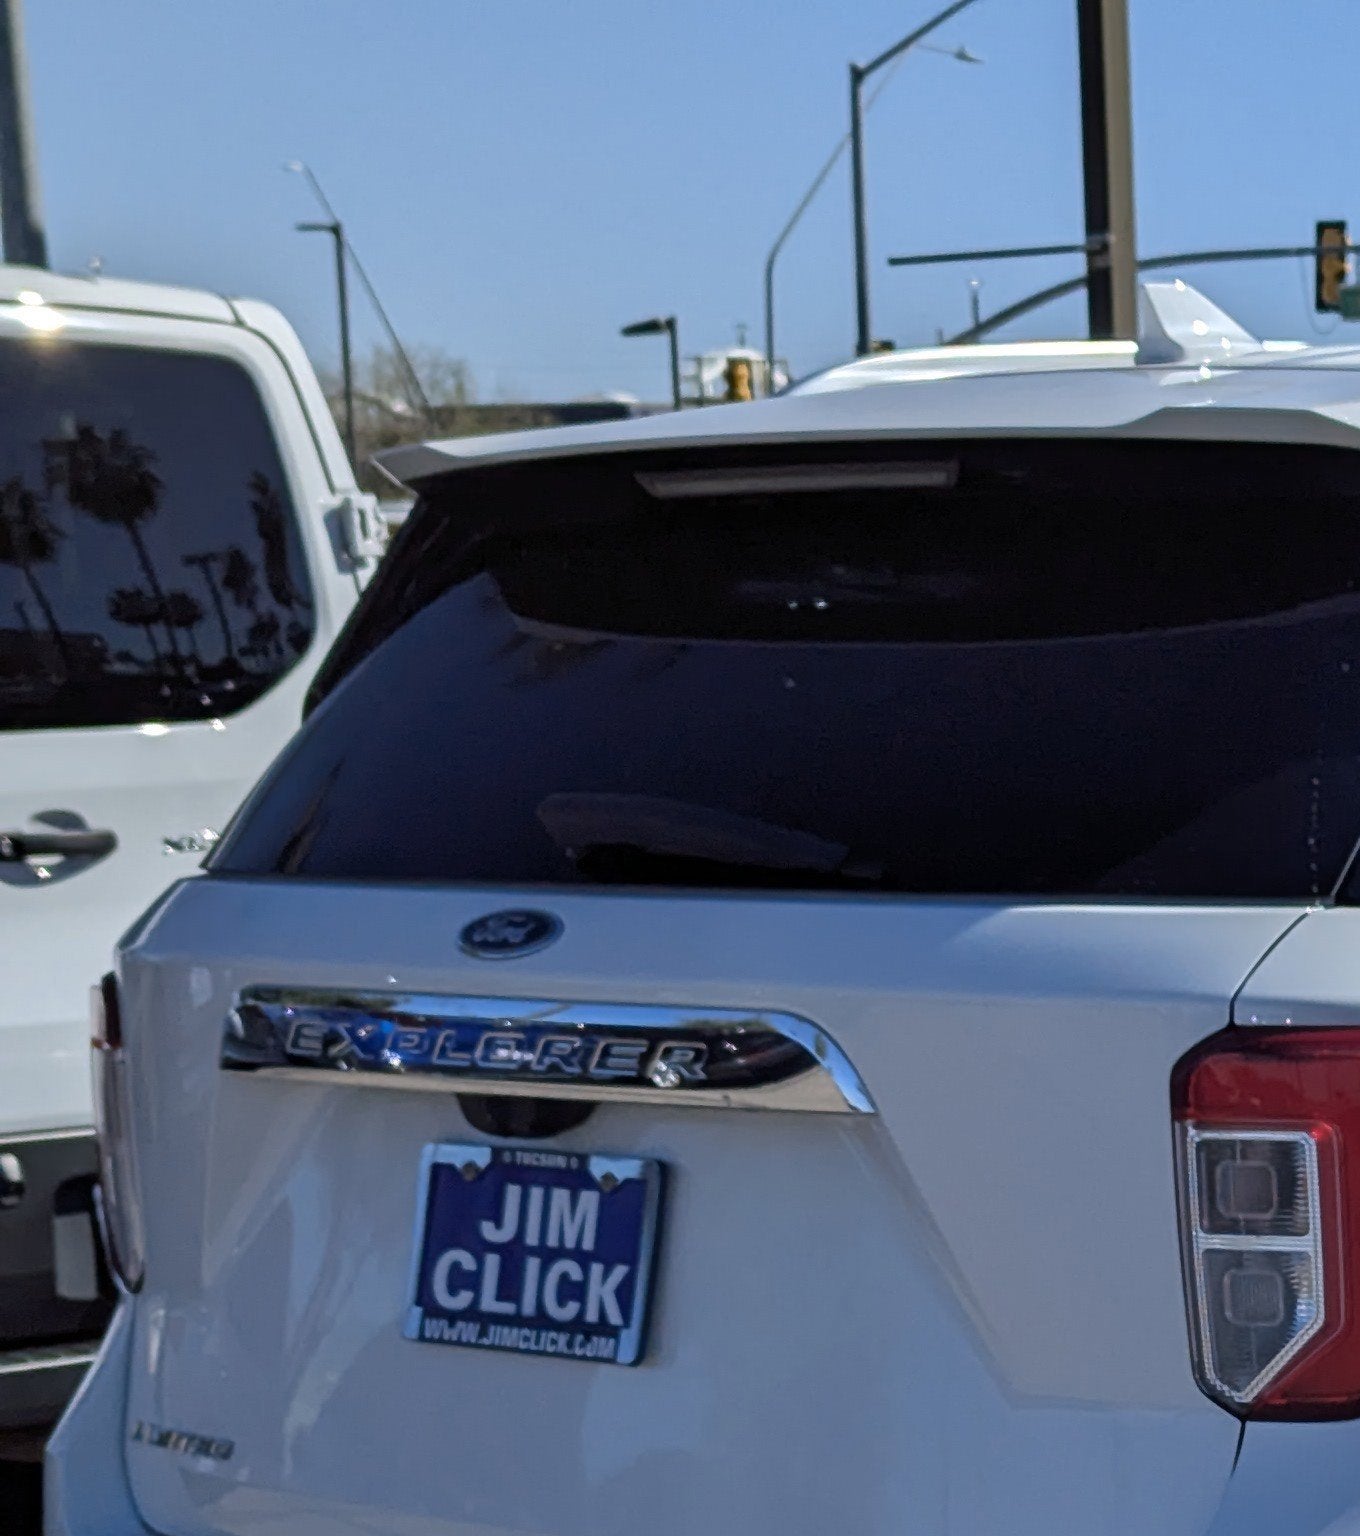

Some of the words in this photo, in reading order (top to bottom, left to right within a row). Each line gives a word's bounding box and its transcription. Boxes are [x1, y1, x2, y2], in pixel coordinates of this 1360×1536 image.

[284, 1017, 708, 1086] EXPLORER
[479, 1182, 600, 1251] JIM
[432, 1248, 631, 1327] CLICK
[423, 1316, 617, 1359] WWW.JIMCLICK.COM
